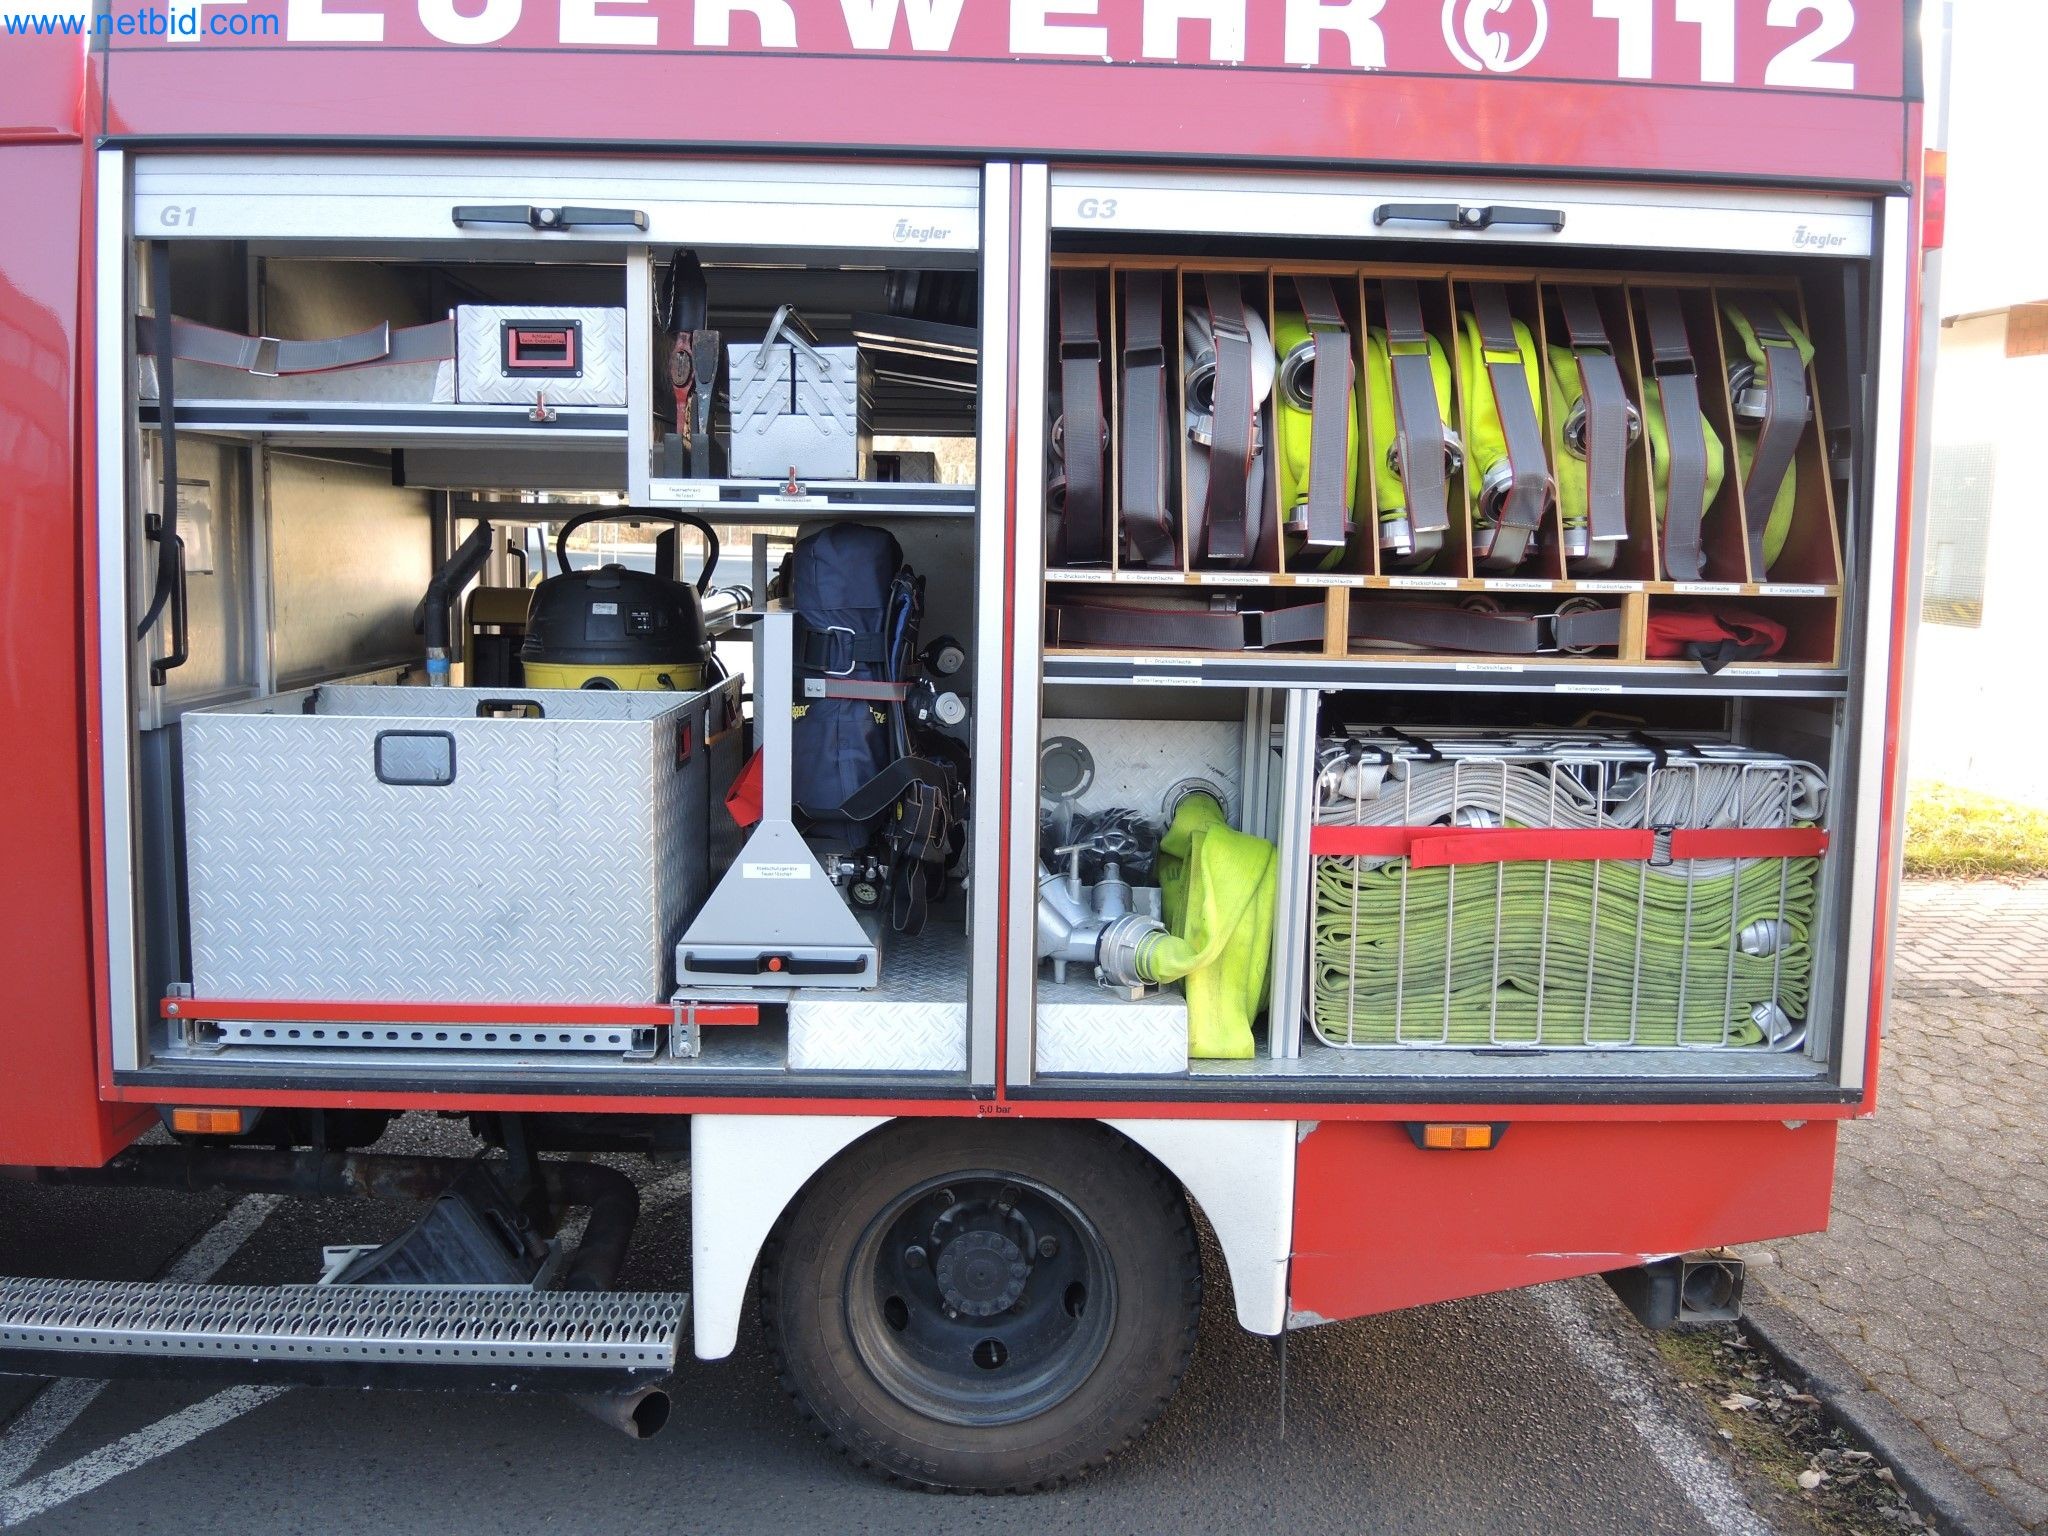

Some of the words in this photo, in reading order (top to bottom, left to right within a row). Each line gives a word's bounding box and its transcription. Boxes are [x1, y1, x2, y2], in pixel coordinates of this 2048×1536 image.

[1592, 0, 1855, 90] 112
[160, 205, 197, 227] G1
[1077, 198, 1118, 219] G3
[893, 217, 951, 243] Ziegler
[1791, 225, 1847, 249] Ziegler
[995, 1104, 1012, 1114] bar
